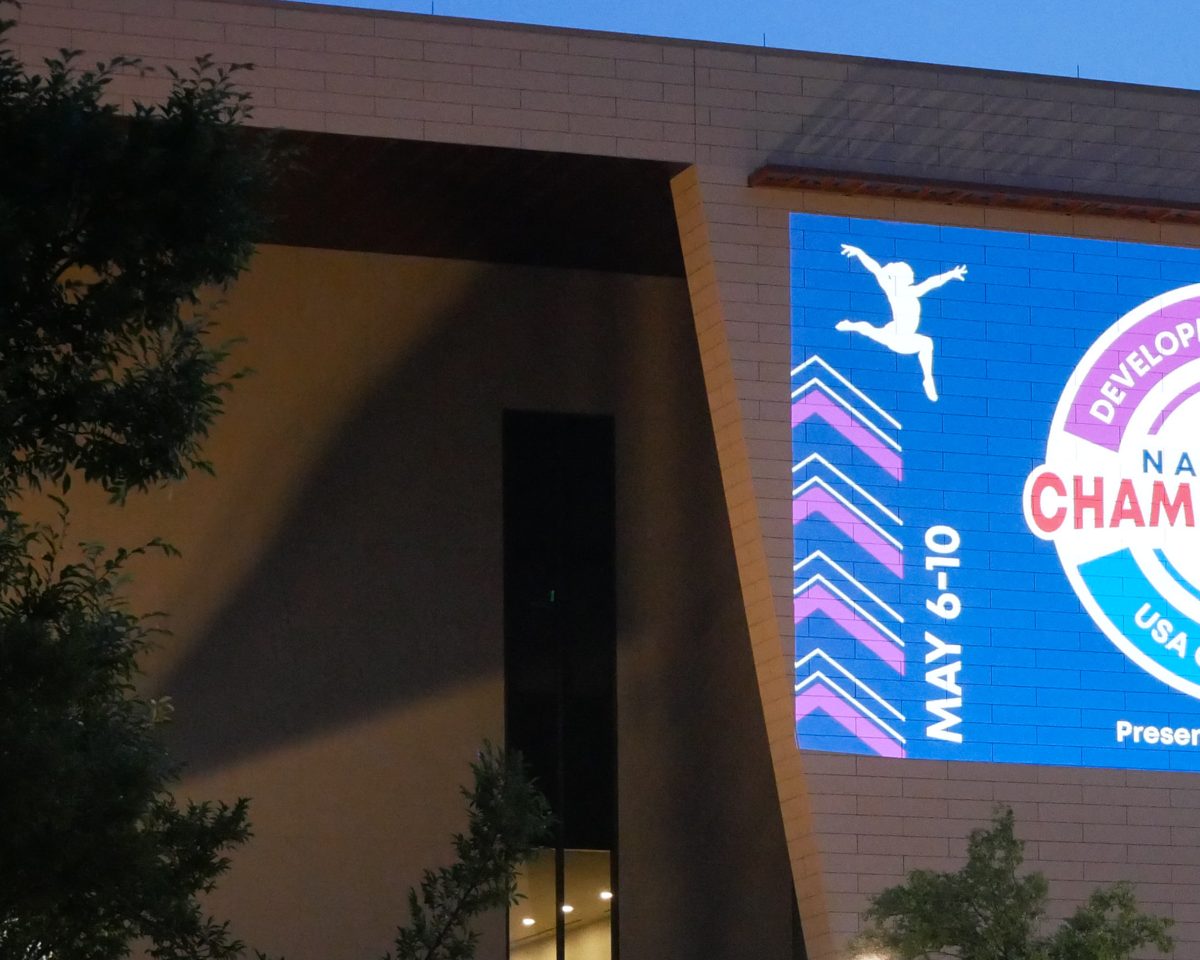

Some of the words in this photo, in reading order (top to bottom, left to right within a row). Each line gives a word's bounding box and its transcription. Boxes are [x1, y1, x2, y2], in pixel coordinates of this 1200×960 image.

[924, 525, 962, 620] 6-10
[1134, 602, 1186, 659] USA
[924, 631, 963, 744] MAY
